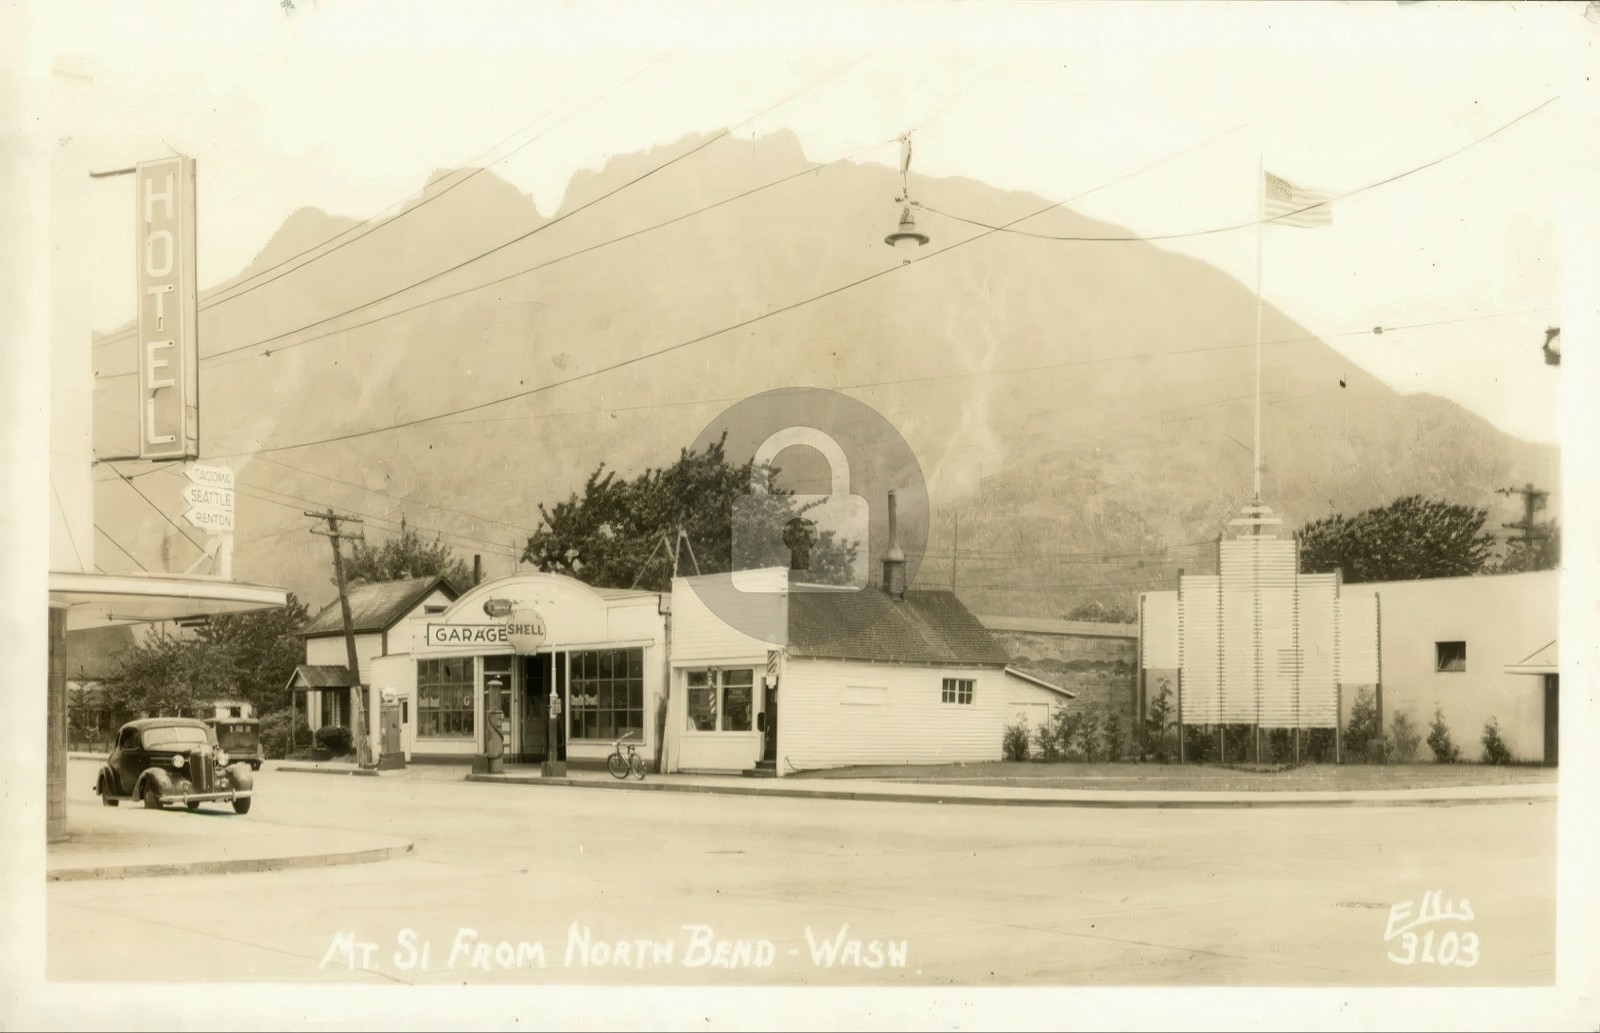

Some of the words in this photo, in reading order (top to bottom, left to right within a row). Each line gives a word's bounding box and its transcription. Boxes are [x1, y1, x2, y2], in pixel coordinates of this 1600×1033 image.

[144, 171, 176, 445] HOTEL
[191, 488, 232, 507] SEATTLE
[195, 511, 232, 527] RENTON
[435, 627, 508, 642] GARAGE
[507, 624, 544, 636] SHELL
